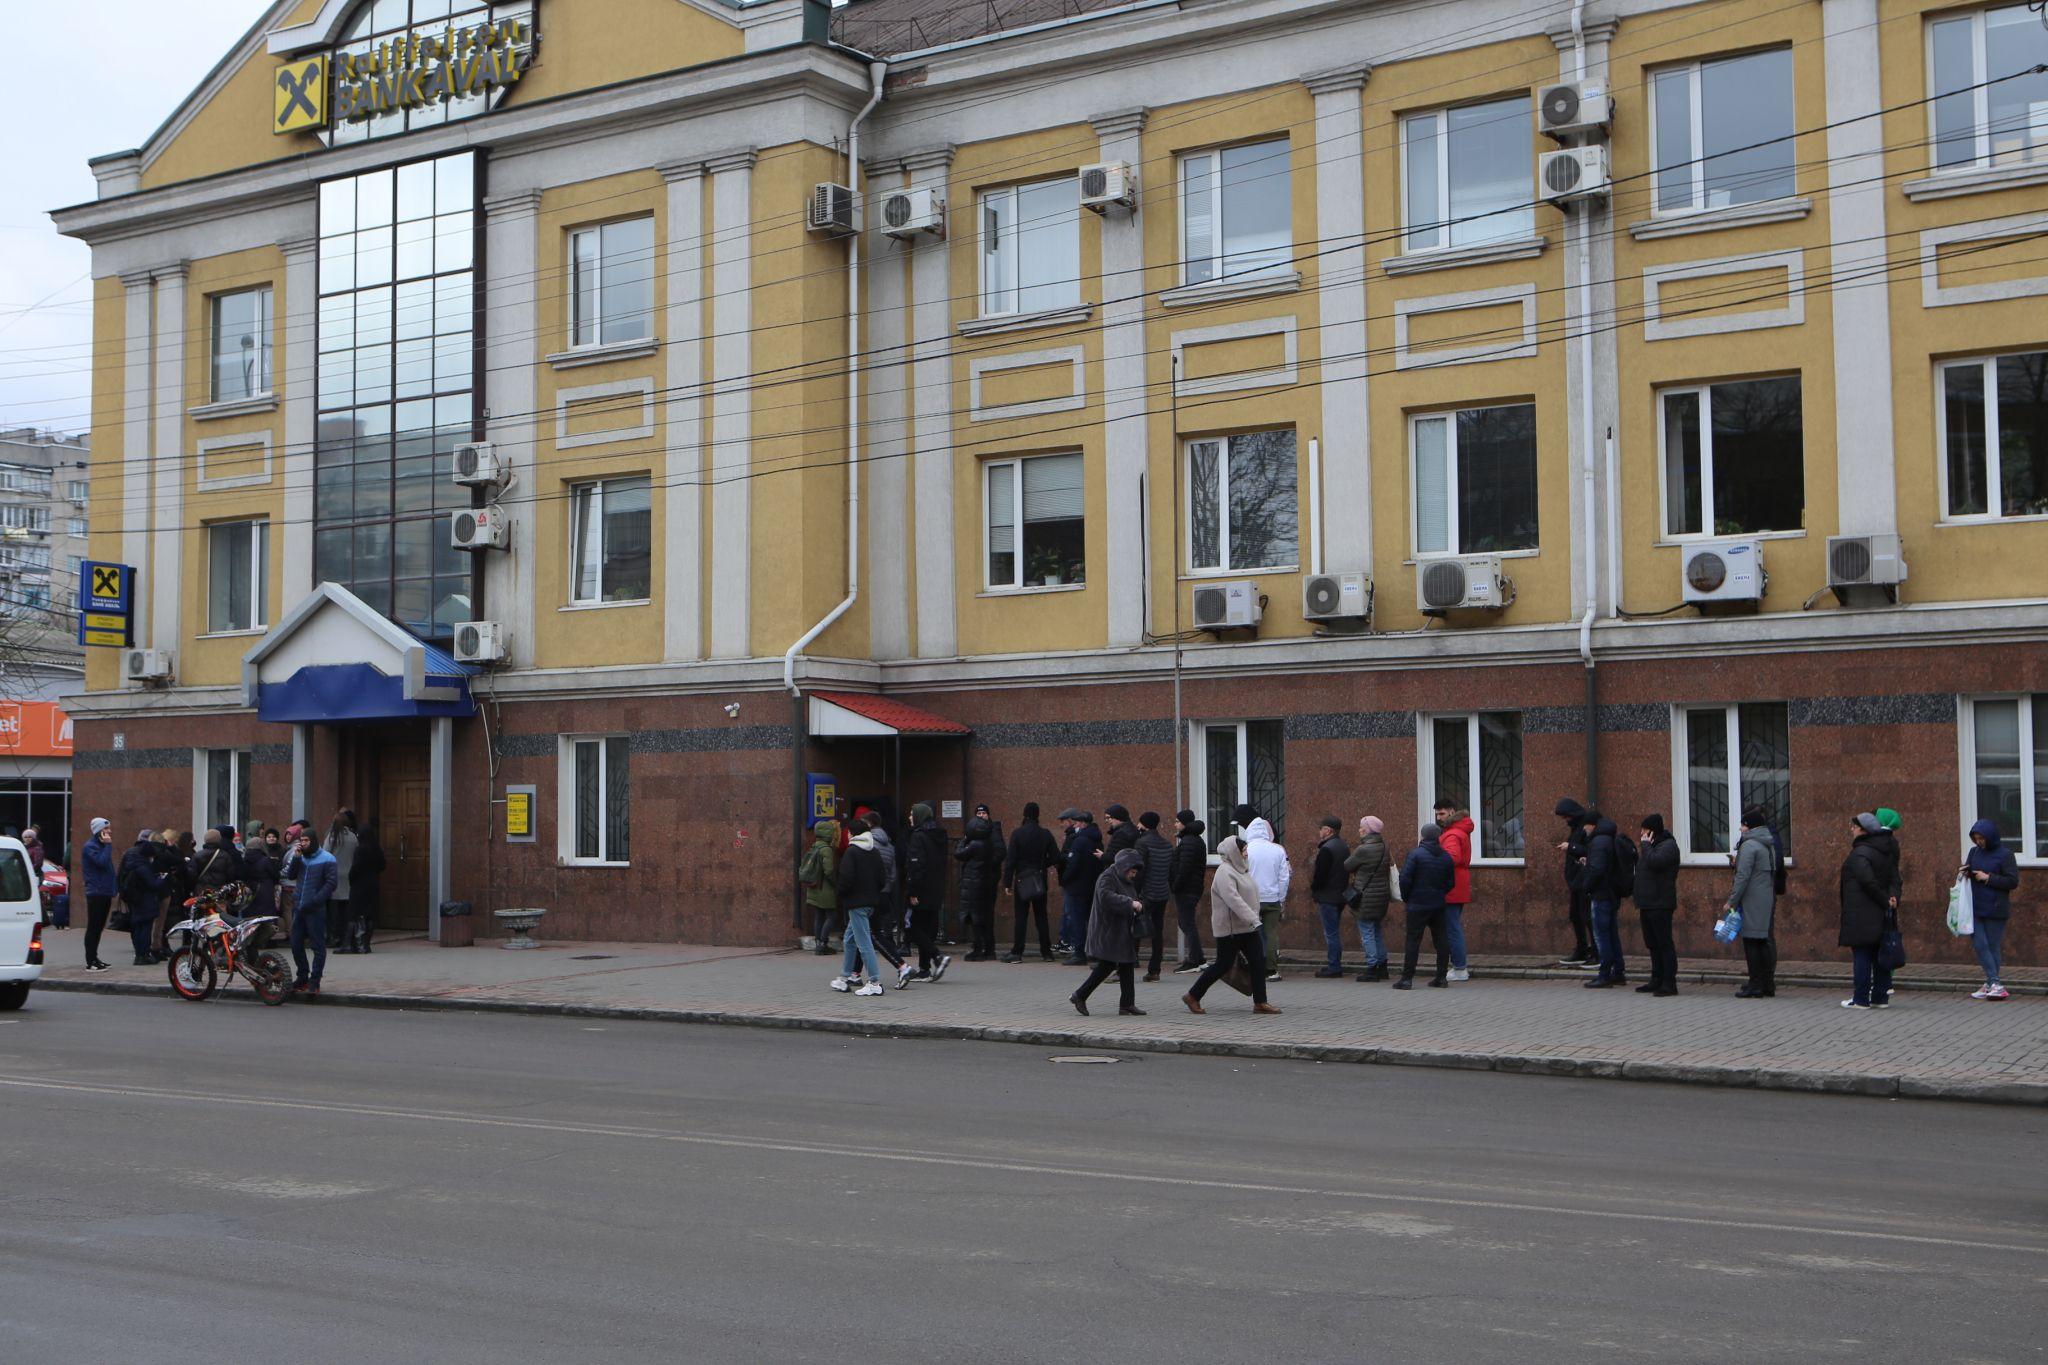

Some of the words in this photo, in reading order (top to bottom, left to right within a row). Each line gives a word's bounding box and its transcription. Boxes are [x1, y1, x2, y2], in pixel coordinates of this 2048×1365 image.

[335, 18, 520, 80] Raiffeisen
[334, 65, 426, 120] BANK
[427, 47, 520, 97] AVAL
[113, 736, 123, 748] 35
